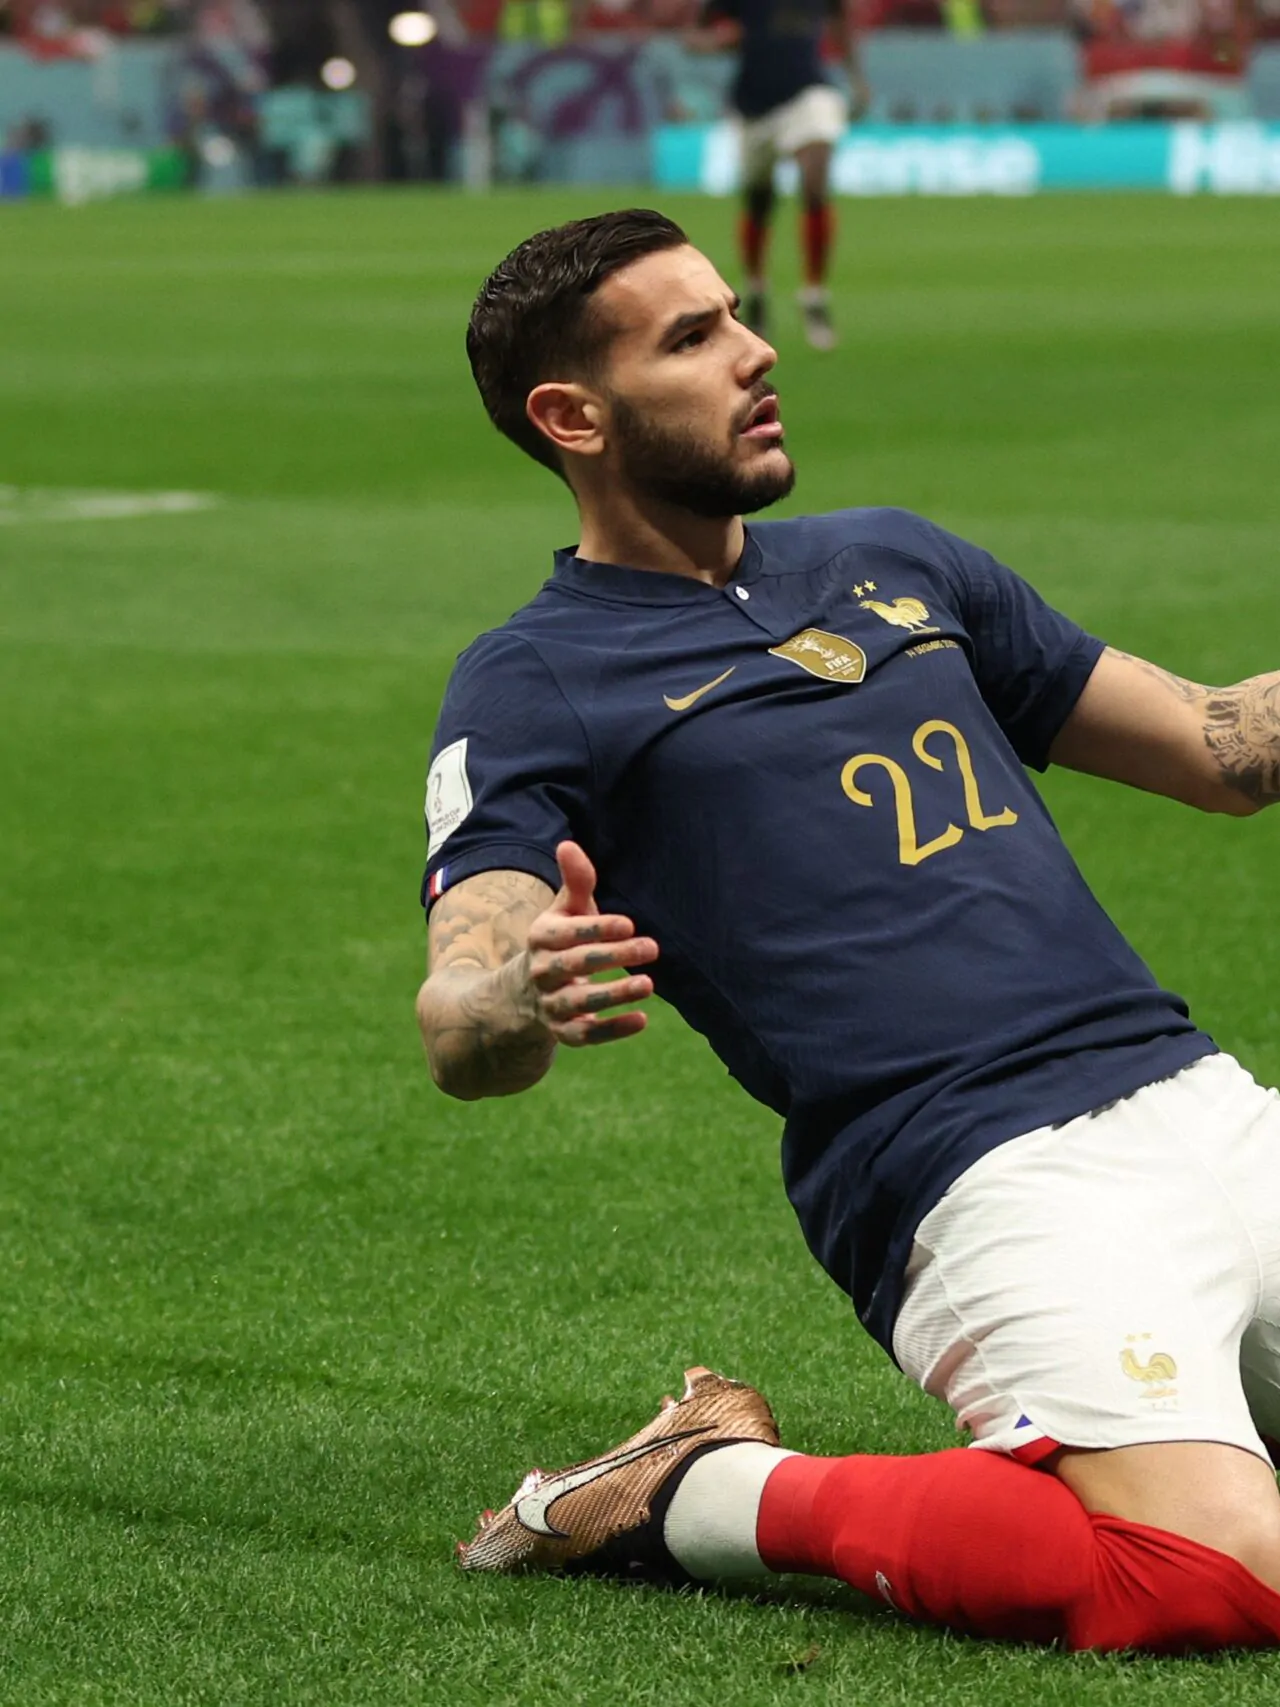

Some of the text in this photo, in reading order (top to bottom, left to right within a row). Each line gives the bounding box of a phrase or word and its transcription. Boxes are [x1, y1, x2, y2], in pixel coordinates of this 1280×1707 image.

[702, 119, 1038, 194] ense
[825, 654, 851, 670] FIFA
[841, 719, 1018, 866] 22
